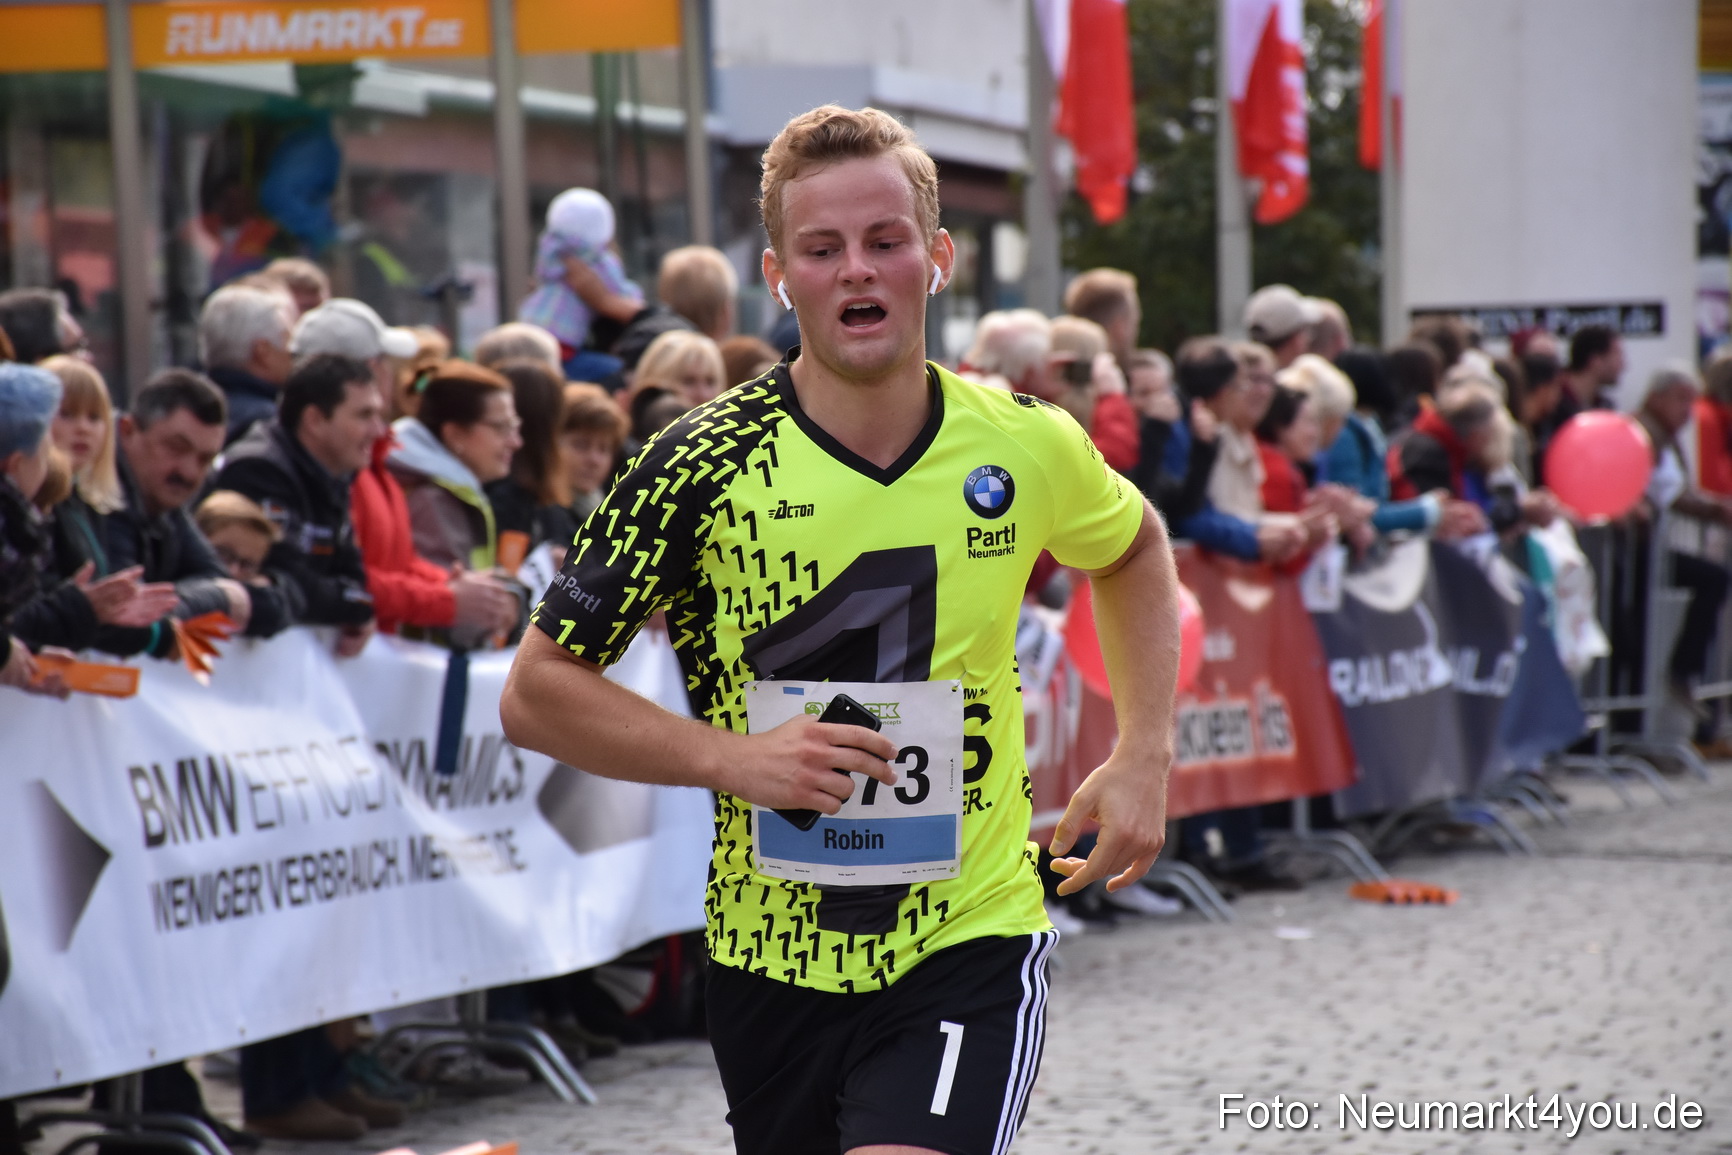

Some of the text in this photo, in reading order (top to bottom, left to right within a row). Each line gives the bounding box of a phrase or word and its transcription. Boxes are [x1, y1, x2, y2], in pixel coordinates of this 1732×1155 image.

[966, 466, 1010, 485] BMW
[966, 522, 1016, 548] Partl
[967, 545, 1015, 559] Neumarkt
[562, 575, 602, 614] Partl
[128, 754, 240, 849] BMW
[824, 828, 884, 850] Robin
[150, 863, 264, 934] WENIGER
[930, 1020, 965, 1116] 1
